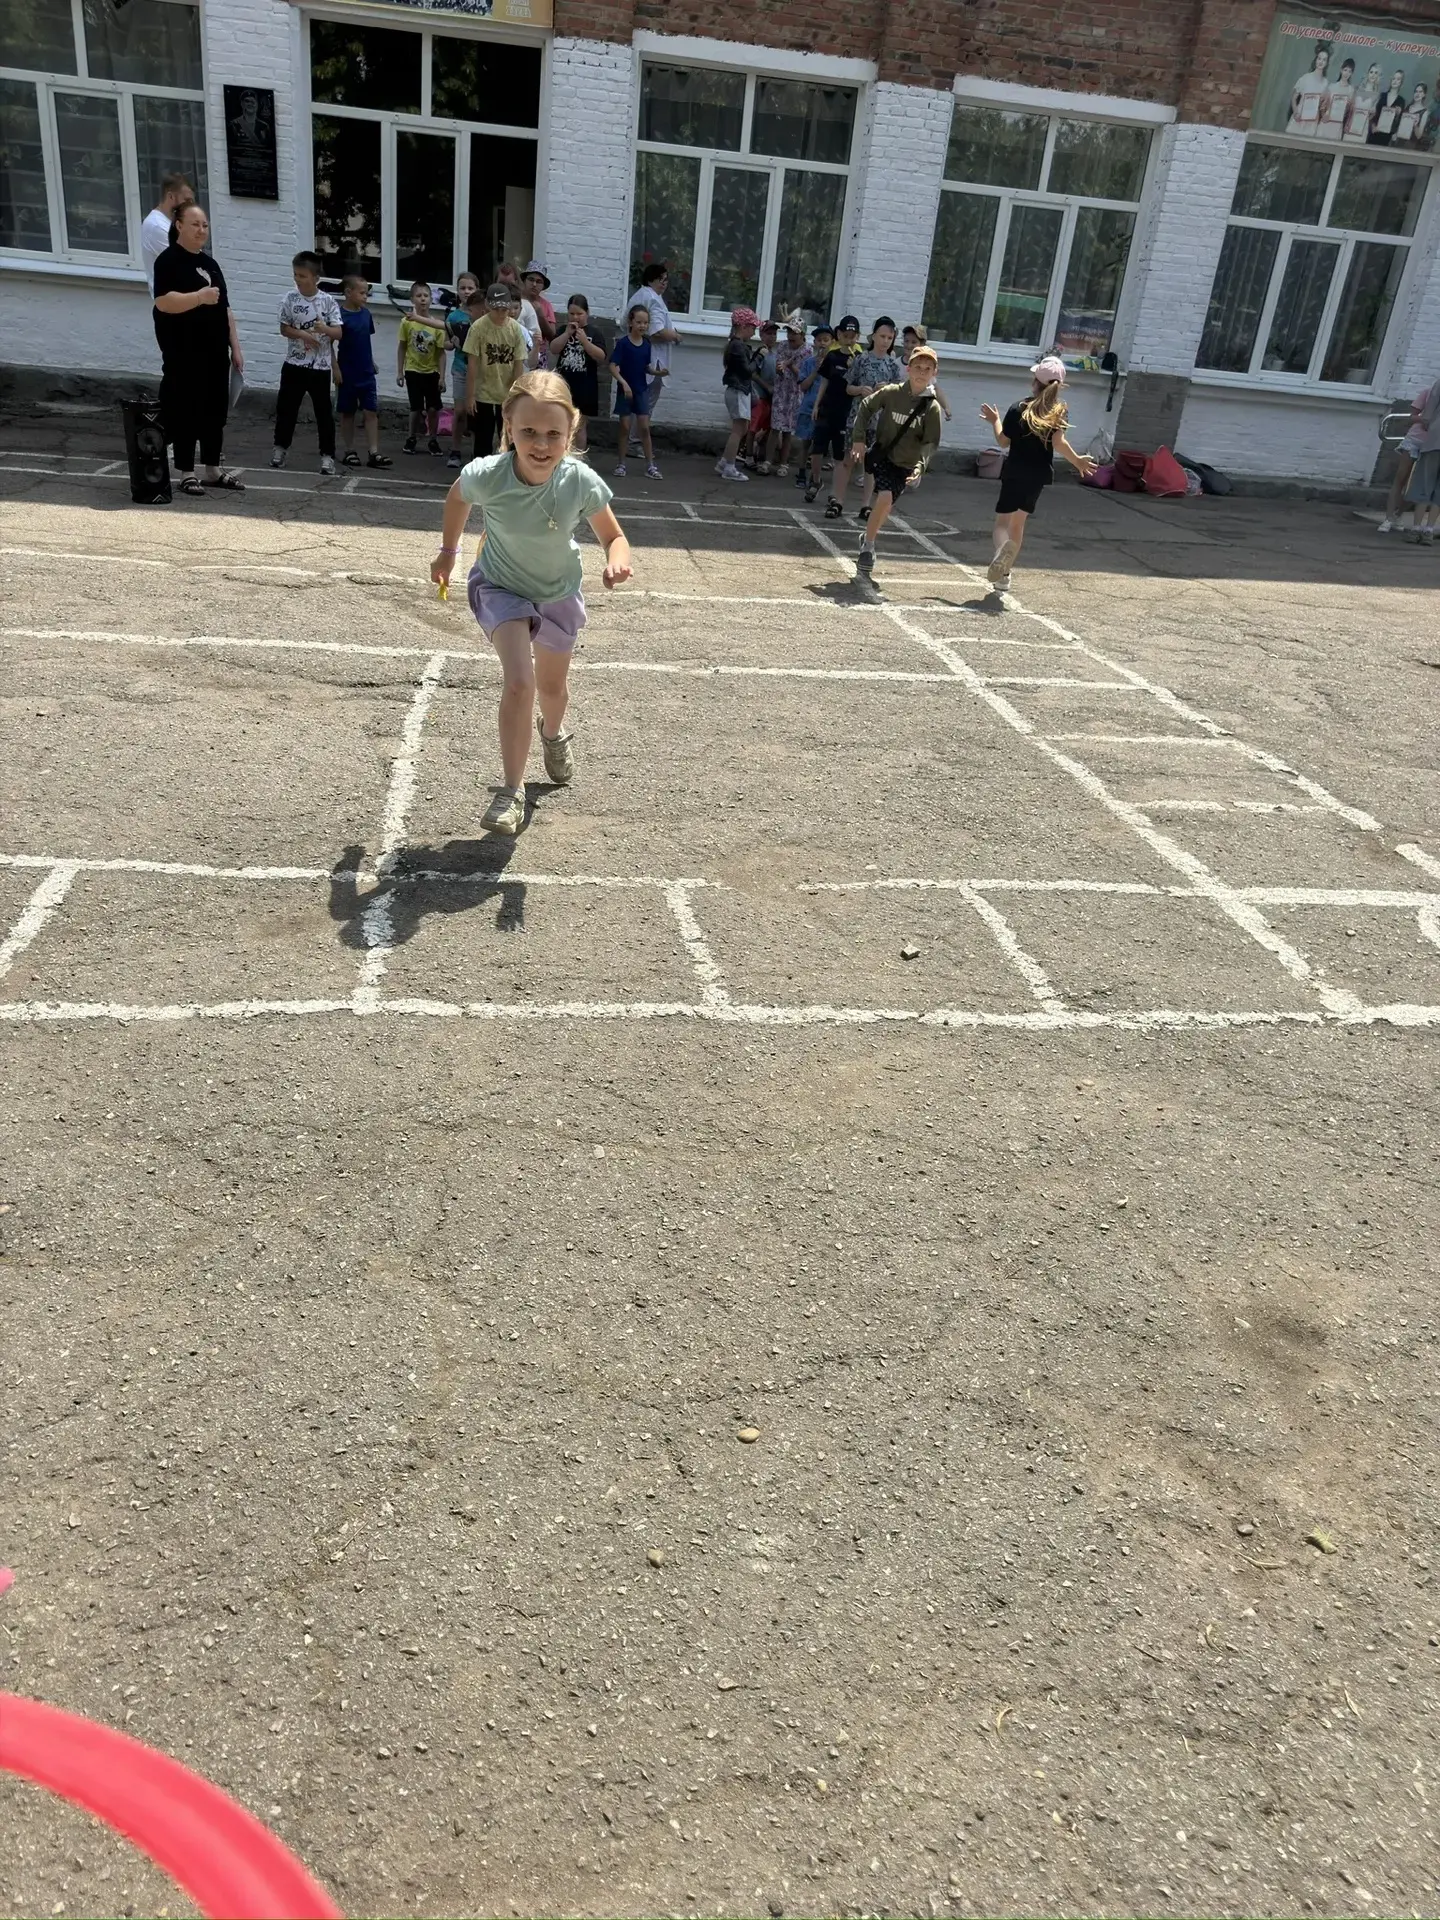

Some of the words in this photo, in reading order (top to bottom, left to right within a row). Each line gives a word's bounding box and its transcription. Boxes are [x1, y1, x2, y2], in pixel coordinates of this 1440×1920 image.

[1280, 21, 1297, 35] От
[1296, 26, 1334, 40] успеха
[1334, 31, 1343, 42] в
[1343, 33, 1377, 47] школе
[1392, 41, 1429, 58] успеху
